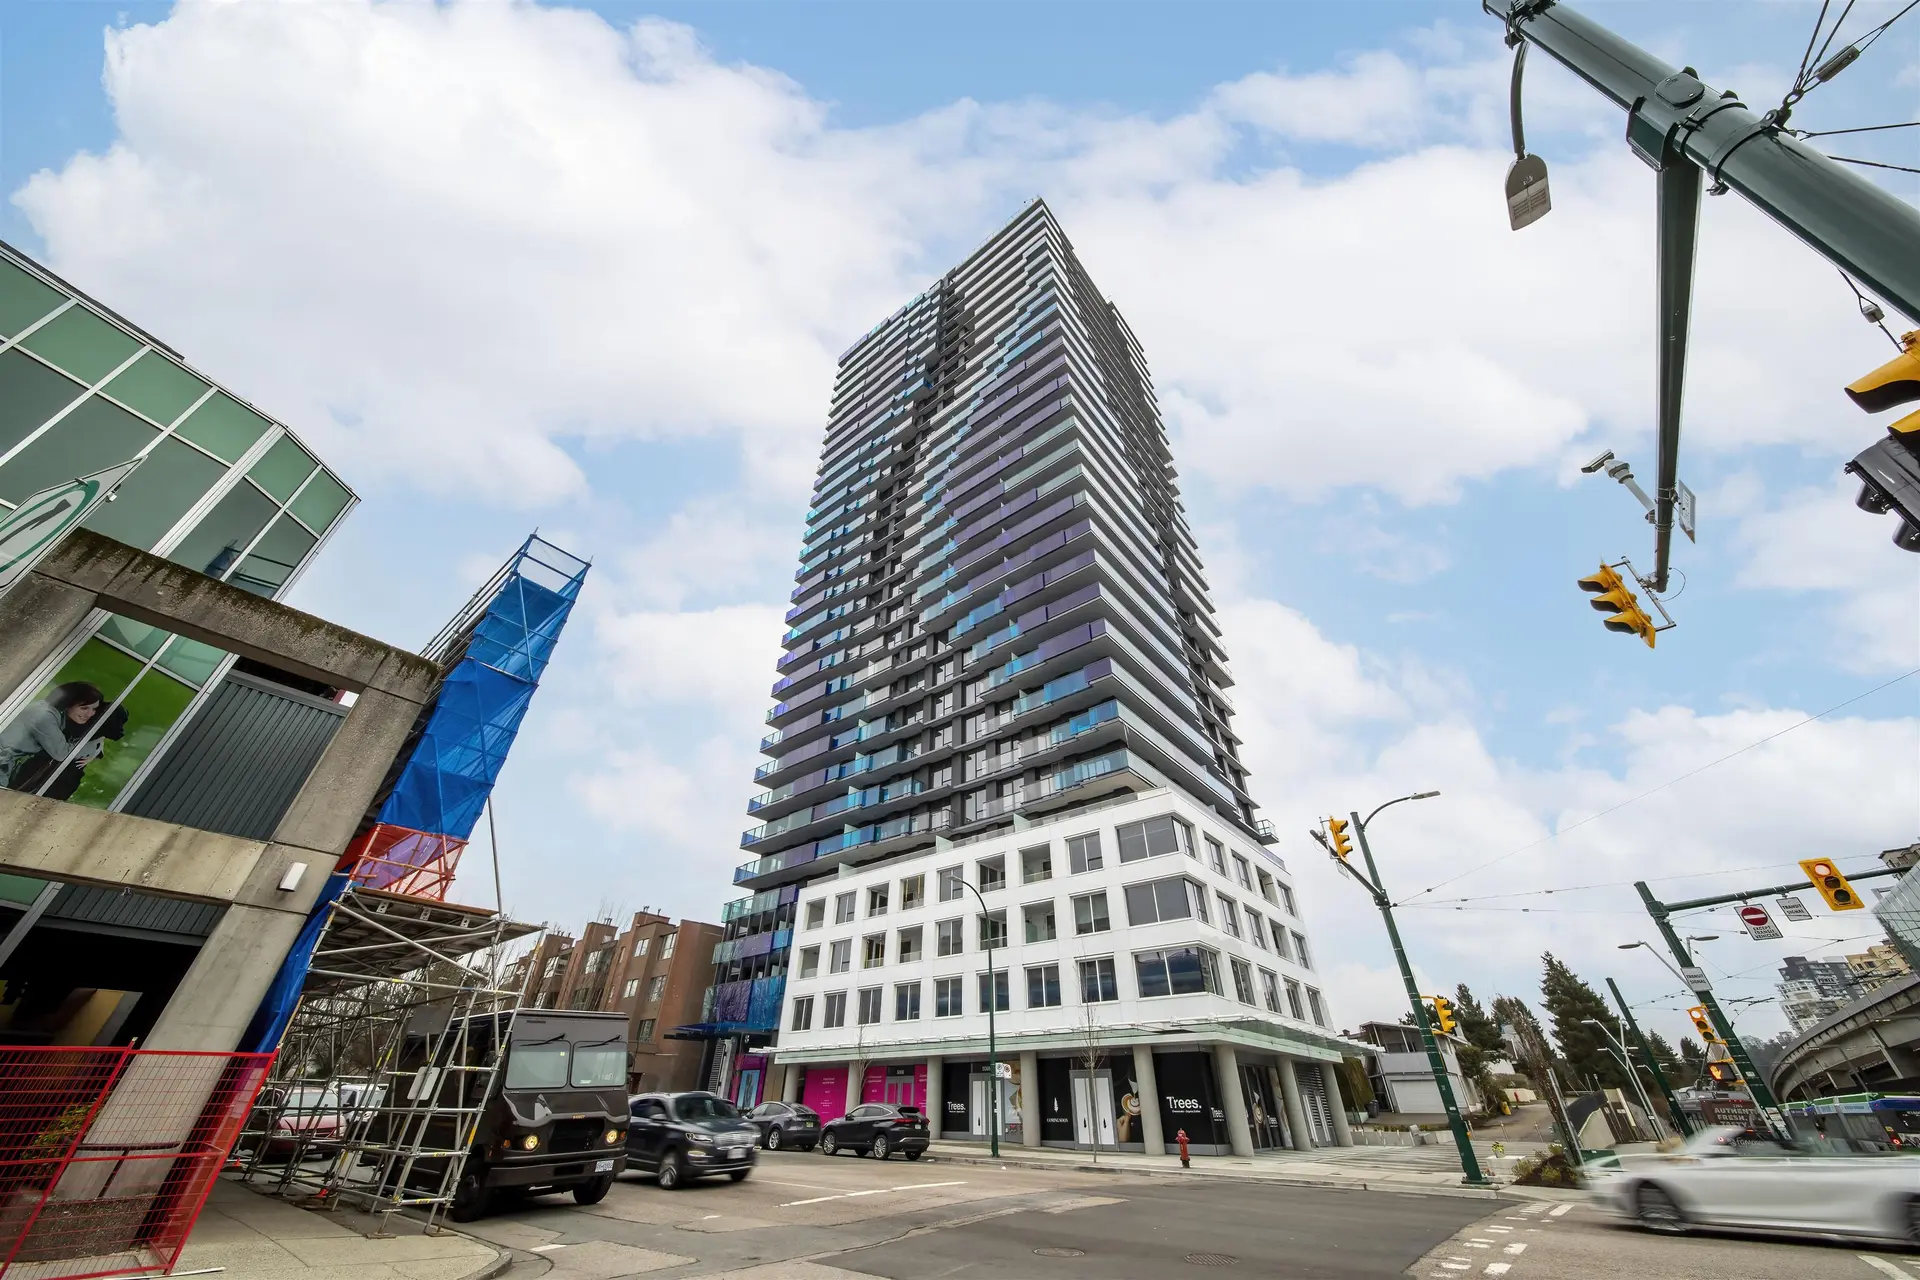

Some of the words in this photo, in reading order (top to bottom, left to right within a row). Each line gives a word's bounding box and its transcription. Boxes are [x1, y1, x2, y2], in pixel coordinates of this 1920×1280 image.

[947, 1101, 966, 1111] Trees.
[1166, 1096, 1202, 1109] Trees.
[1717, 1114, 1748, 1122] FRESH.
